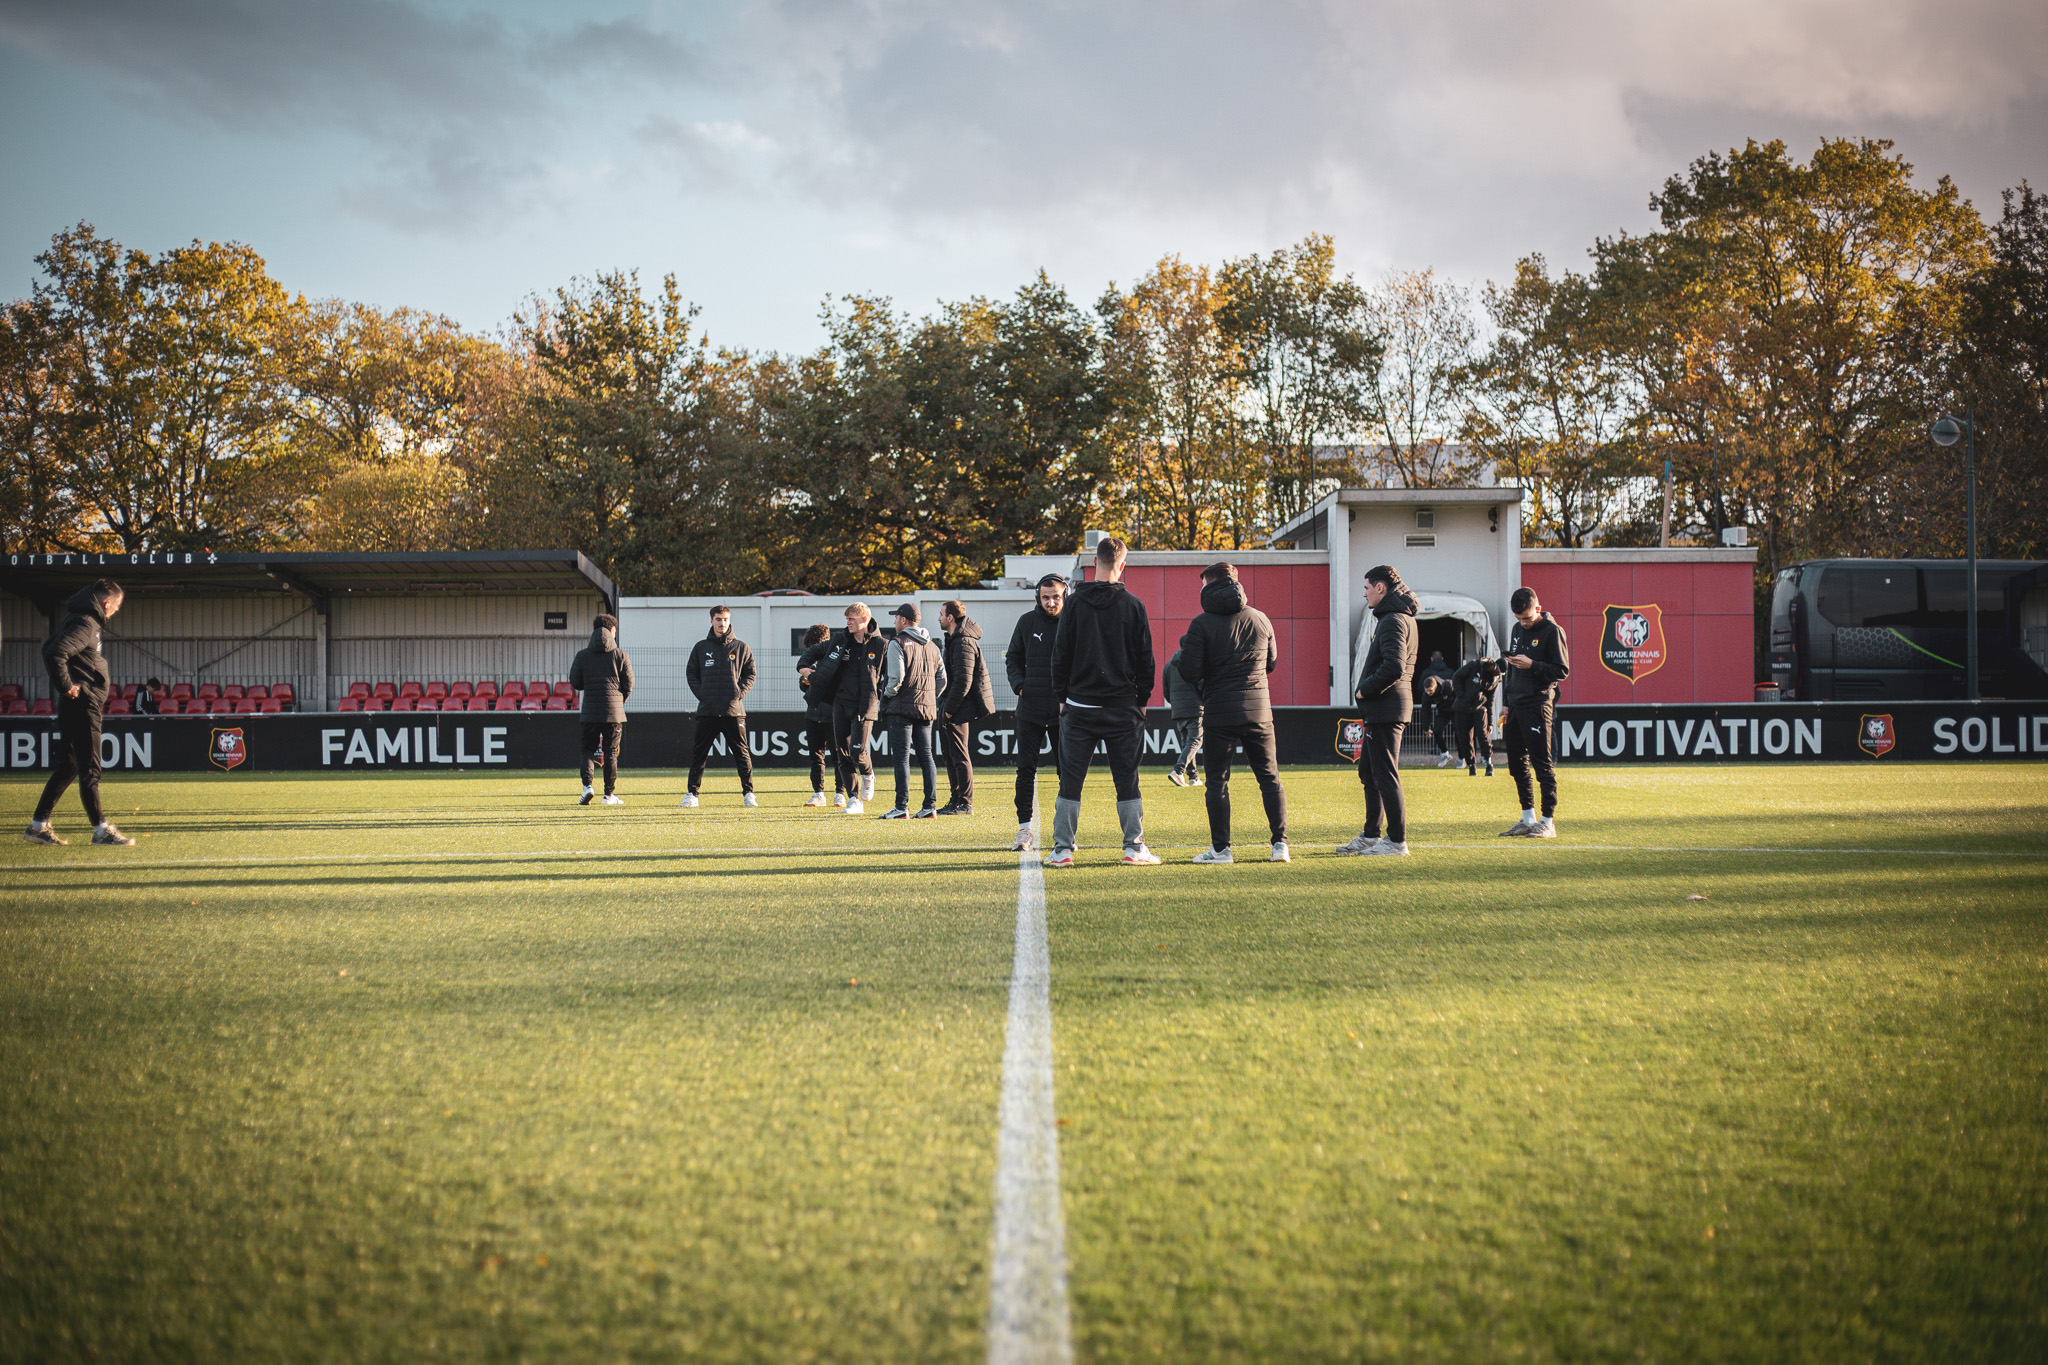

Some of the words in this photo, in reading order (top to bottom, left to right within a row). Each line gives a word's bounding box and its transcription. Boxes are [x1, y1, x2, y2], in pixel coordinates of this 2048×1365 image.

[131, 553, 192, 564] CLUB
[1606, 650, 1628, 658] STADE
[0, 732, 152, 768] BION
[321, 726, 508, 765] FAMILLE
[707, 730, 789, 756] NUS
[1561, 718, 1822, 757] MOTIVATION
[1933, 716, 2048, 754] SOLID
